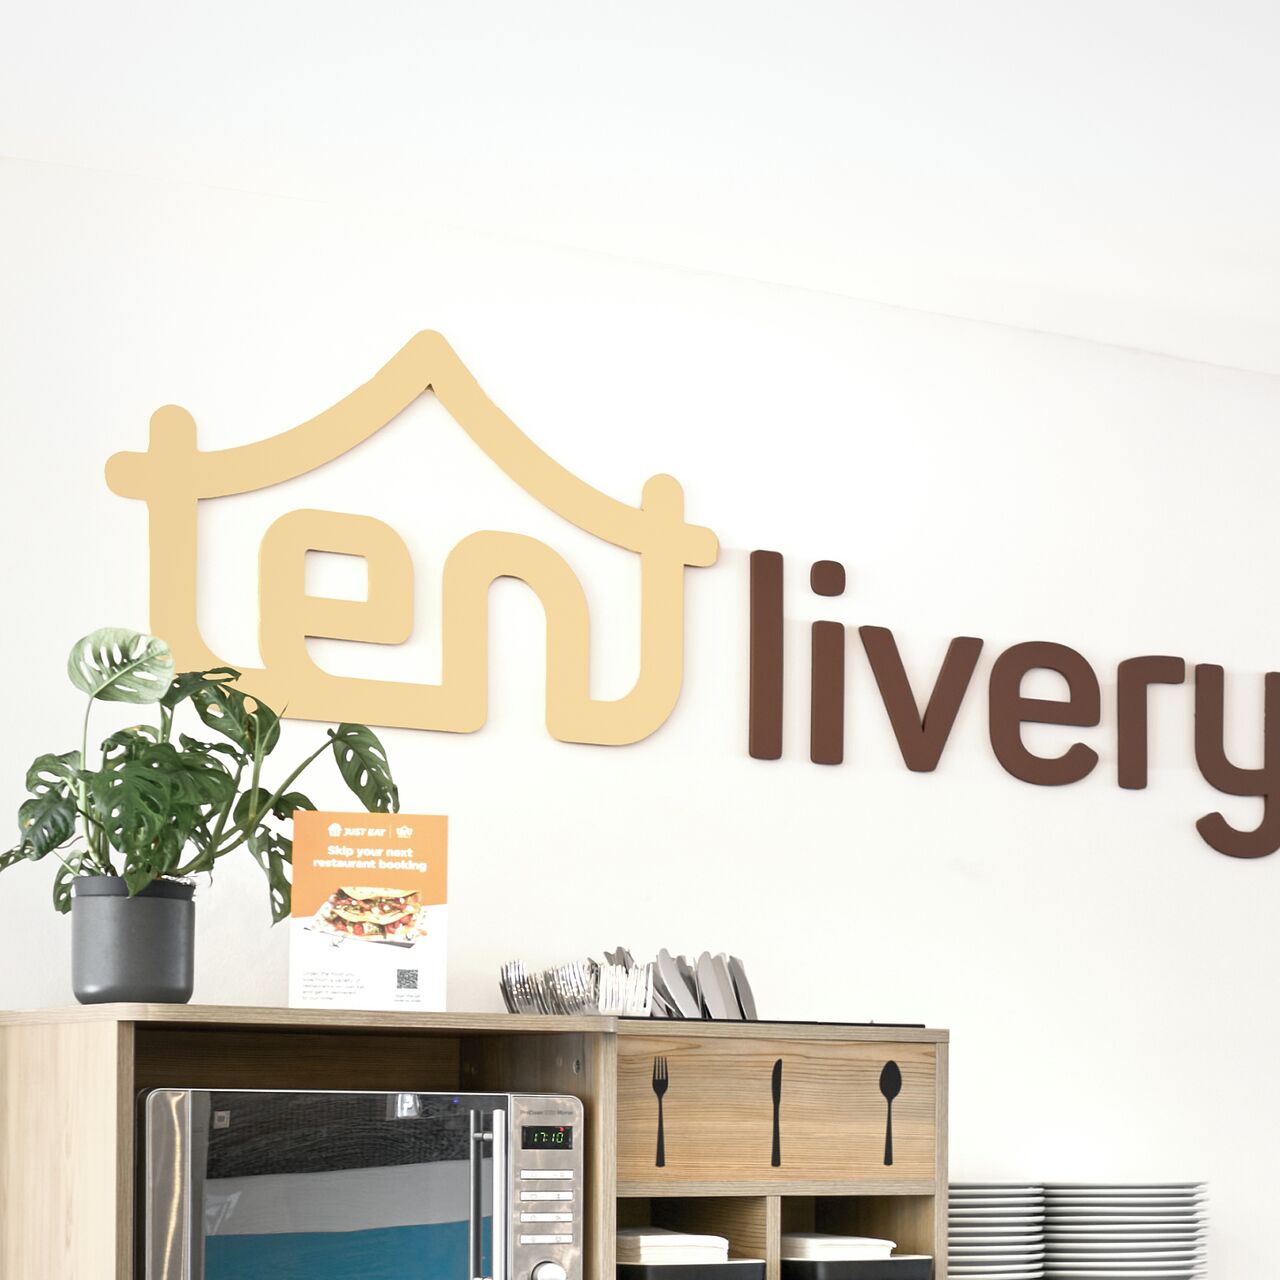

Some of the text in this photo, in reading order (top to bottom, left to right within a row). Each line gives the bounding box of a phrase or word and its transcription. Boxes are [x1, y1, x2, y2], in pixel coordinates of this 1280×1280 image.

[105, 329, 720, 747] tent
[343, 827, 367, 837] JUST
[367, 827, 386, 837] EAT
[327, 845, 413, 858] Skip your next
[313, 858, 427, 872] restaurant booking
[533, 1132, 564, 1144] 17:10
